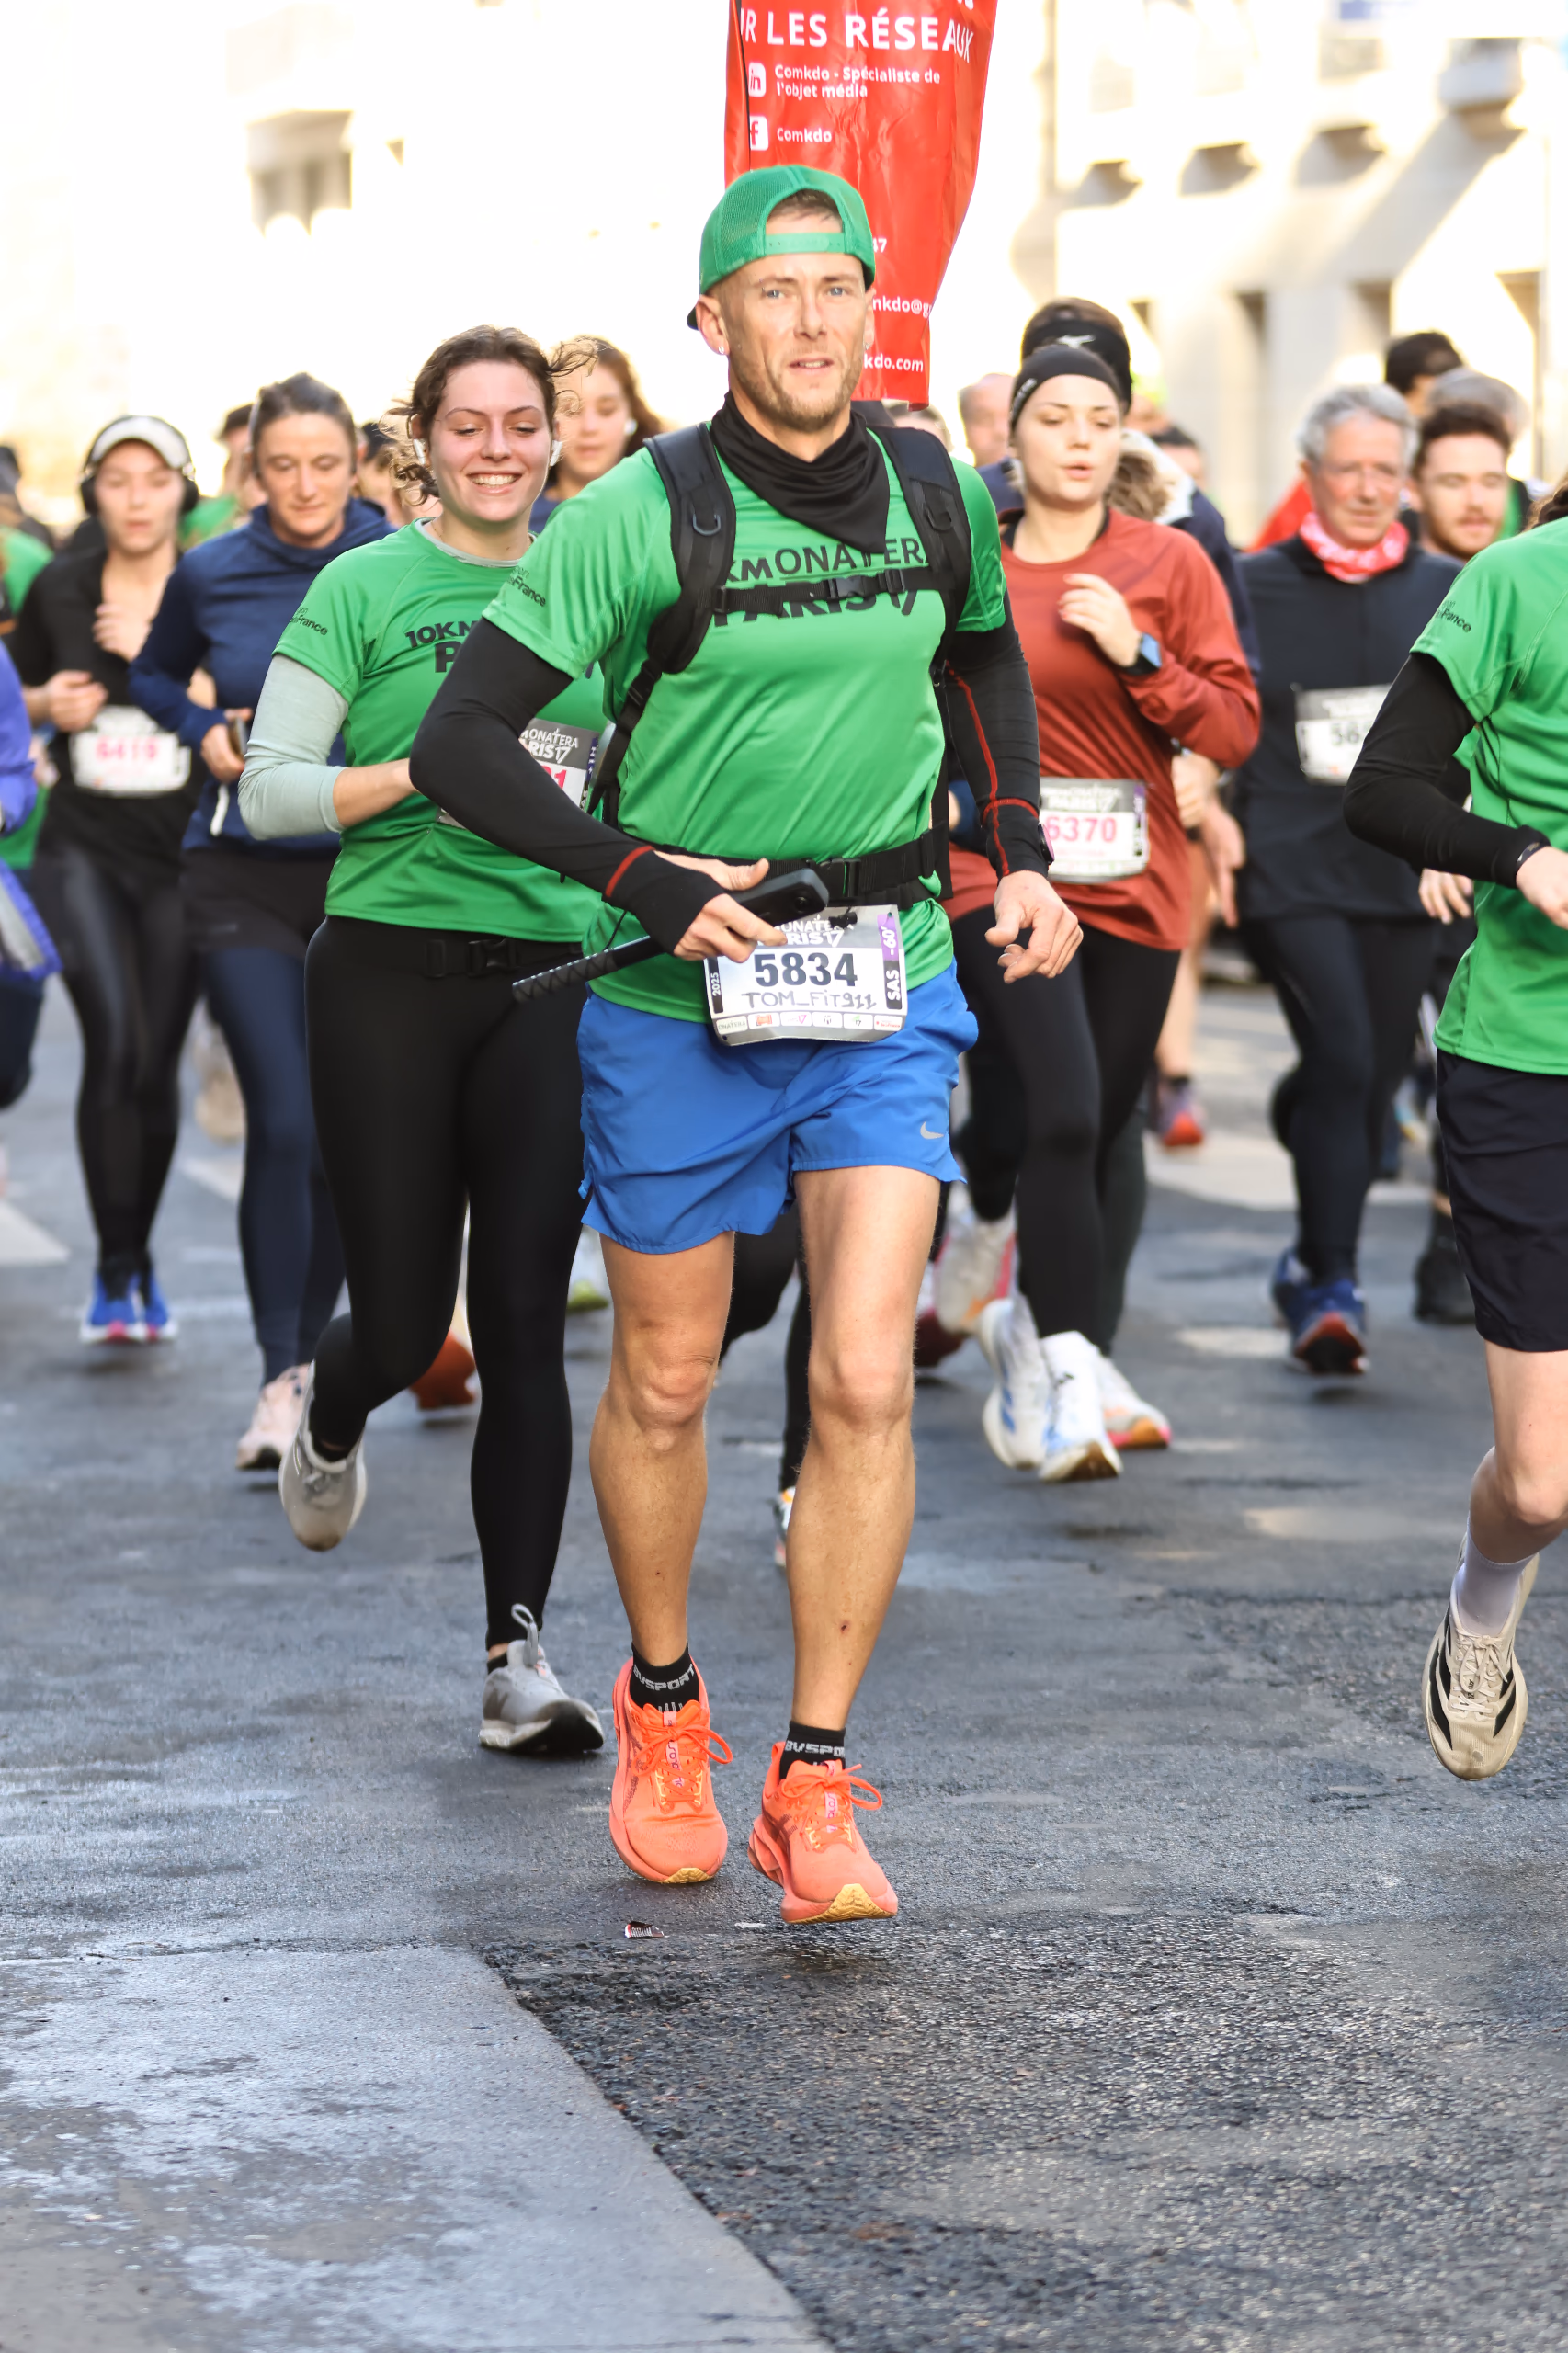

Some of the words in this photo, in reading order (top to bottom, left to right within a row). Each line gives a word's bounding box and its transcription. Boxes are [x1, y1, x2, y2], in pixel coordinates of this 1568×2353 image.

[767, 11, 827, 48] LES
[844, 7, 974, 63] RÉSEAUX
[774, 64, 830, 81] Comkdo
[842, 65, 920, 84] Spécialiste
[924, 68, 940, 84] de
[776, 81, 818, 101] l'objet
[822, 83, 868, 98] média
[776, 128, 833, 143] Comkdo
[1045, 814, 1118, 844] 6370
[754, 952, 858, 988] 5834
[710, 972, 722, 997] 2025
[884, 969, 901, 1001] SAS
